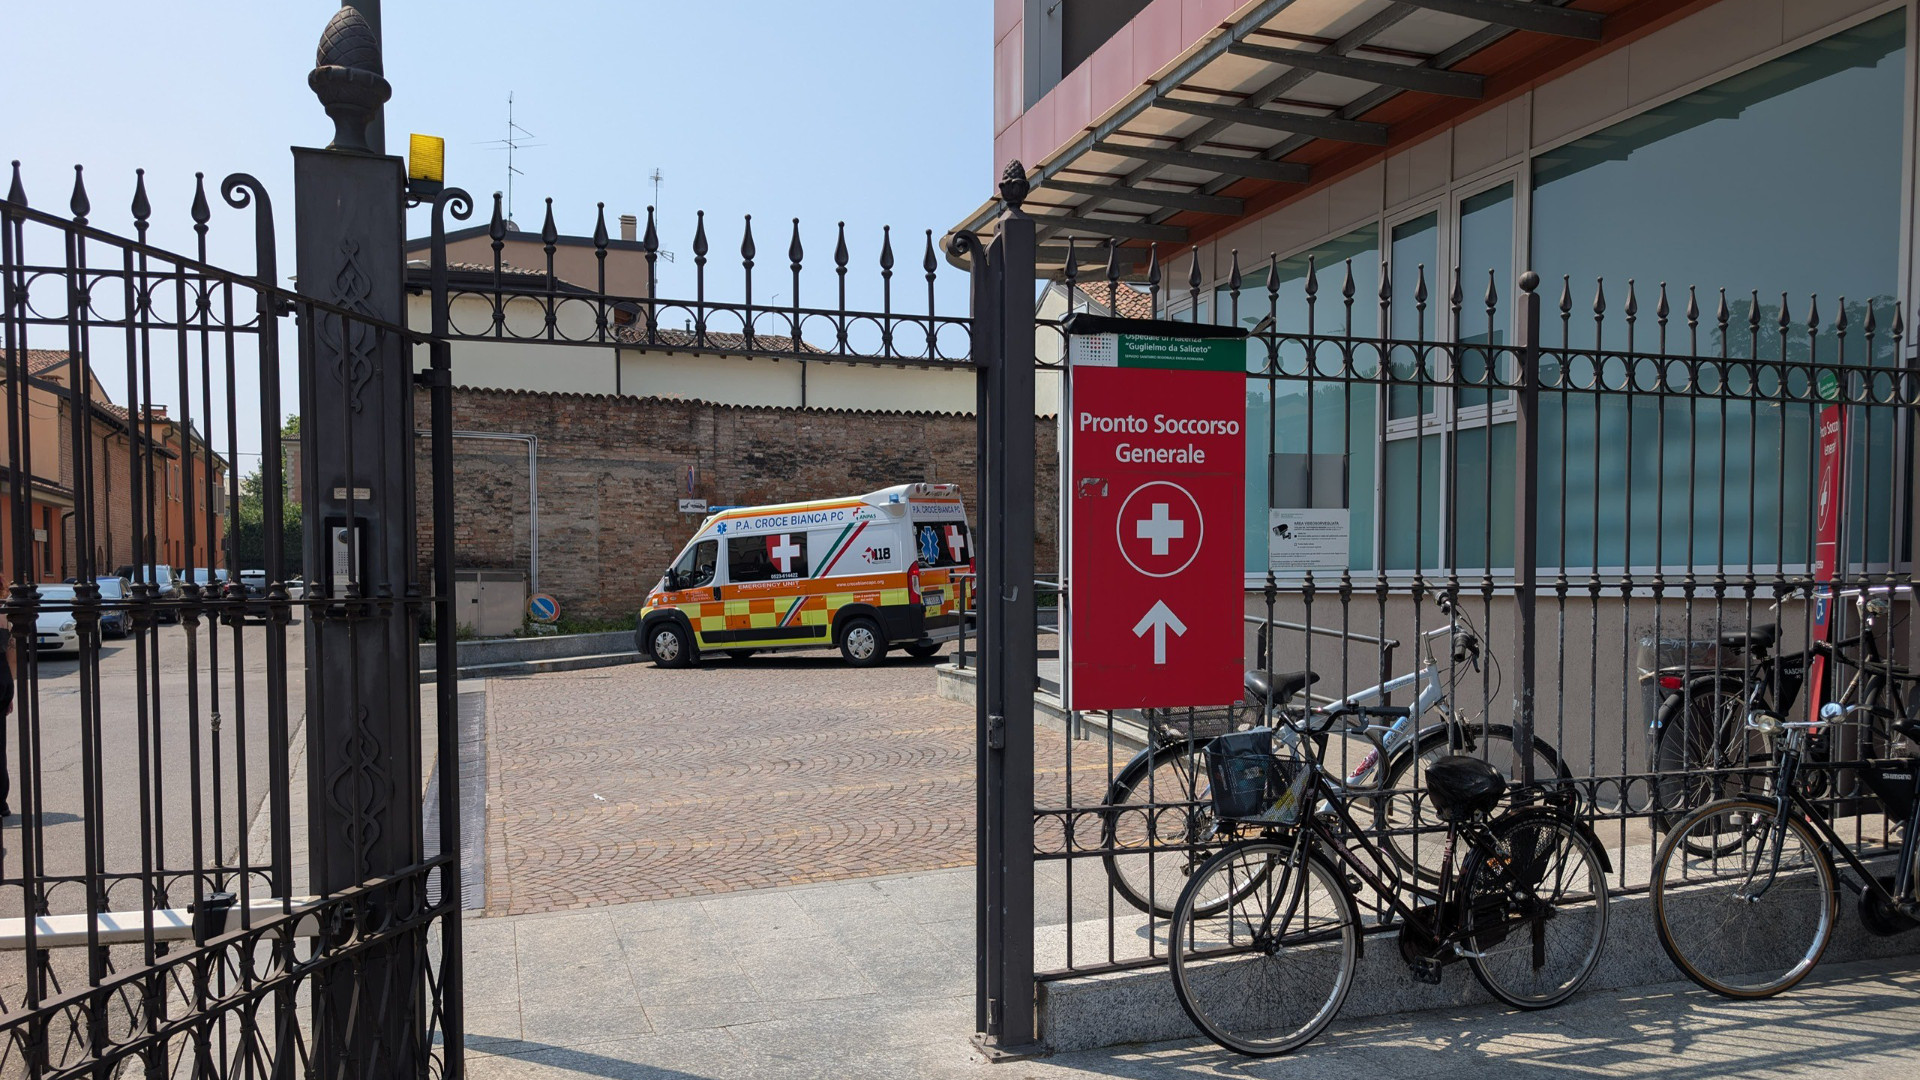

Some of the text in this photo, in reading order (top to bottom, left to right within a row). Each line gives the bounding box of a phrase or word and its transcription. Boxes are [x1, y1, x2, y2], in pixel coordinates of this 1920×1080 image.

[1168, 344, 1178, 352] da
[1080, 412, 1240, 435] Pronto Soccorso
[1115, 443, 1206, 464] Generale
[921, 505, 938, 513] CROCE
[938, 505, 954, 513] BIANCA
[736, 511, 844, 530] P.A. CROCE BIANCA PC
[873, 547, 891, 560] 118
[738, 582, 780, 590] EMERGENCY
[1882, 772, 1912, 781] SHIMANO
